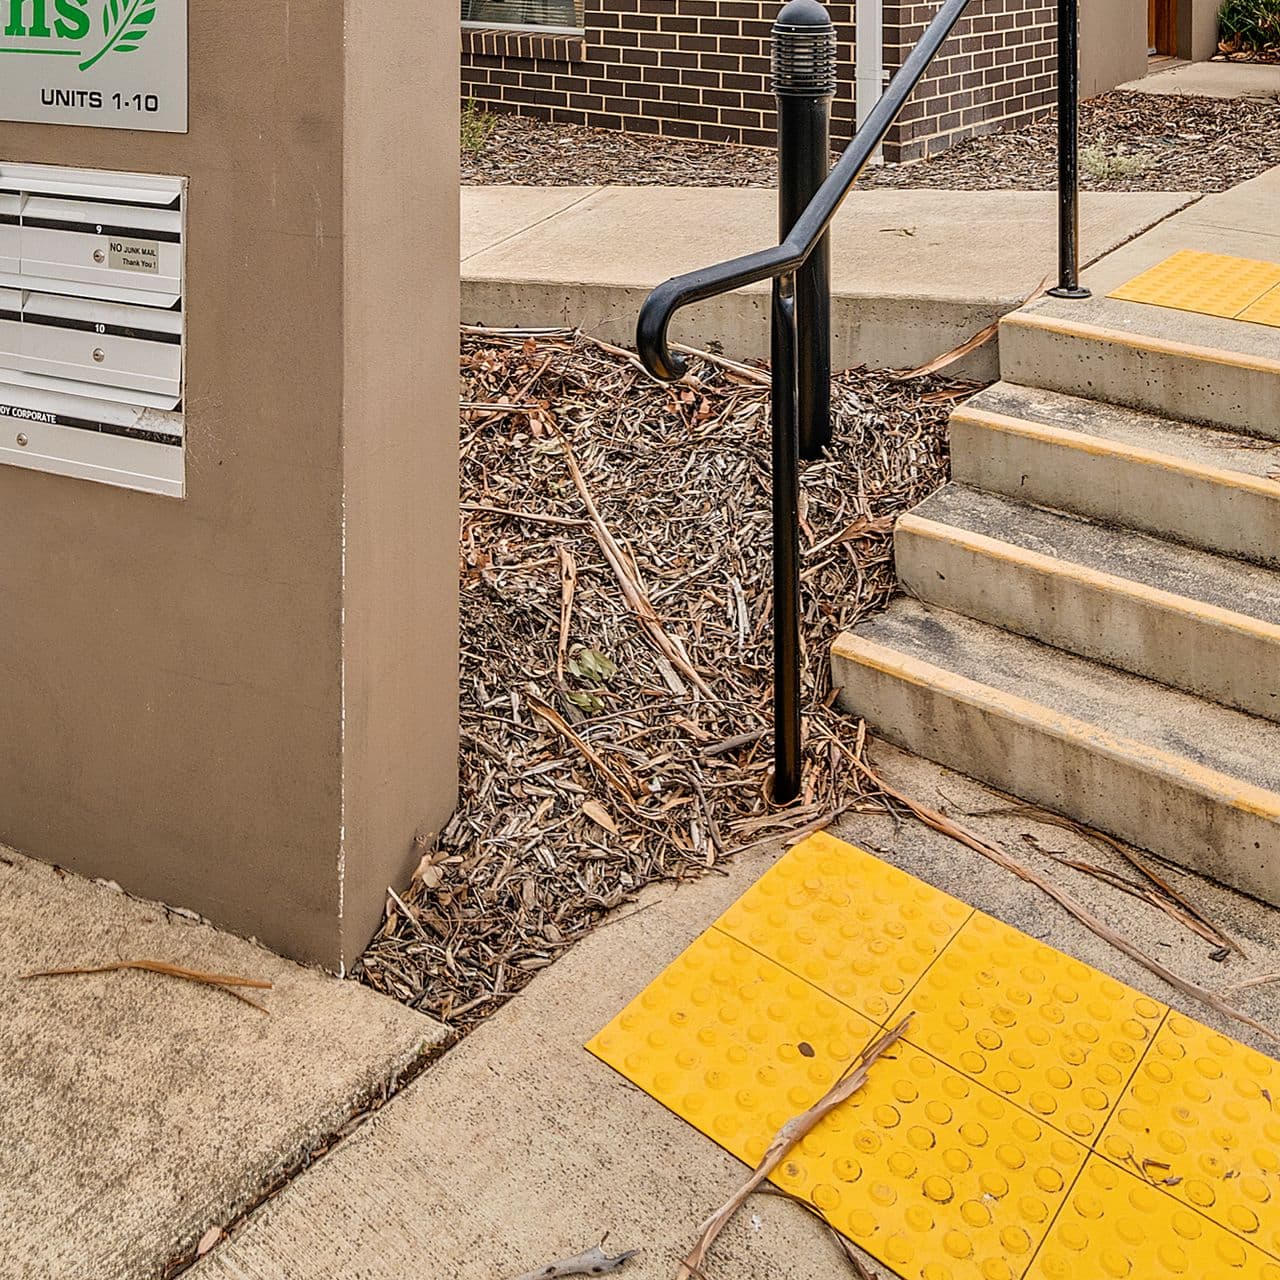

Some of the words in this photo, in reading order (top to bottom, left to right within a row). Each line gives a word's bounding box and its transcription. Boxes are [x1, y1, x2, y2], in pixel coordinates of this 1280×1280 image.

[40, 88, 103, 109] UNITS
[95, 224, 103, 234] 9
[109, 242, 123, 253] NO
[123, 246, 141, 255] JUNK
[141, 247, 157, 257] MAIL
[122, 258, 141, 267] Thank
[95, 324, 105, 333] 10
[12, 407, 57, 424] CORPORATE
